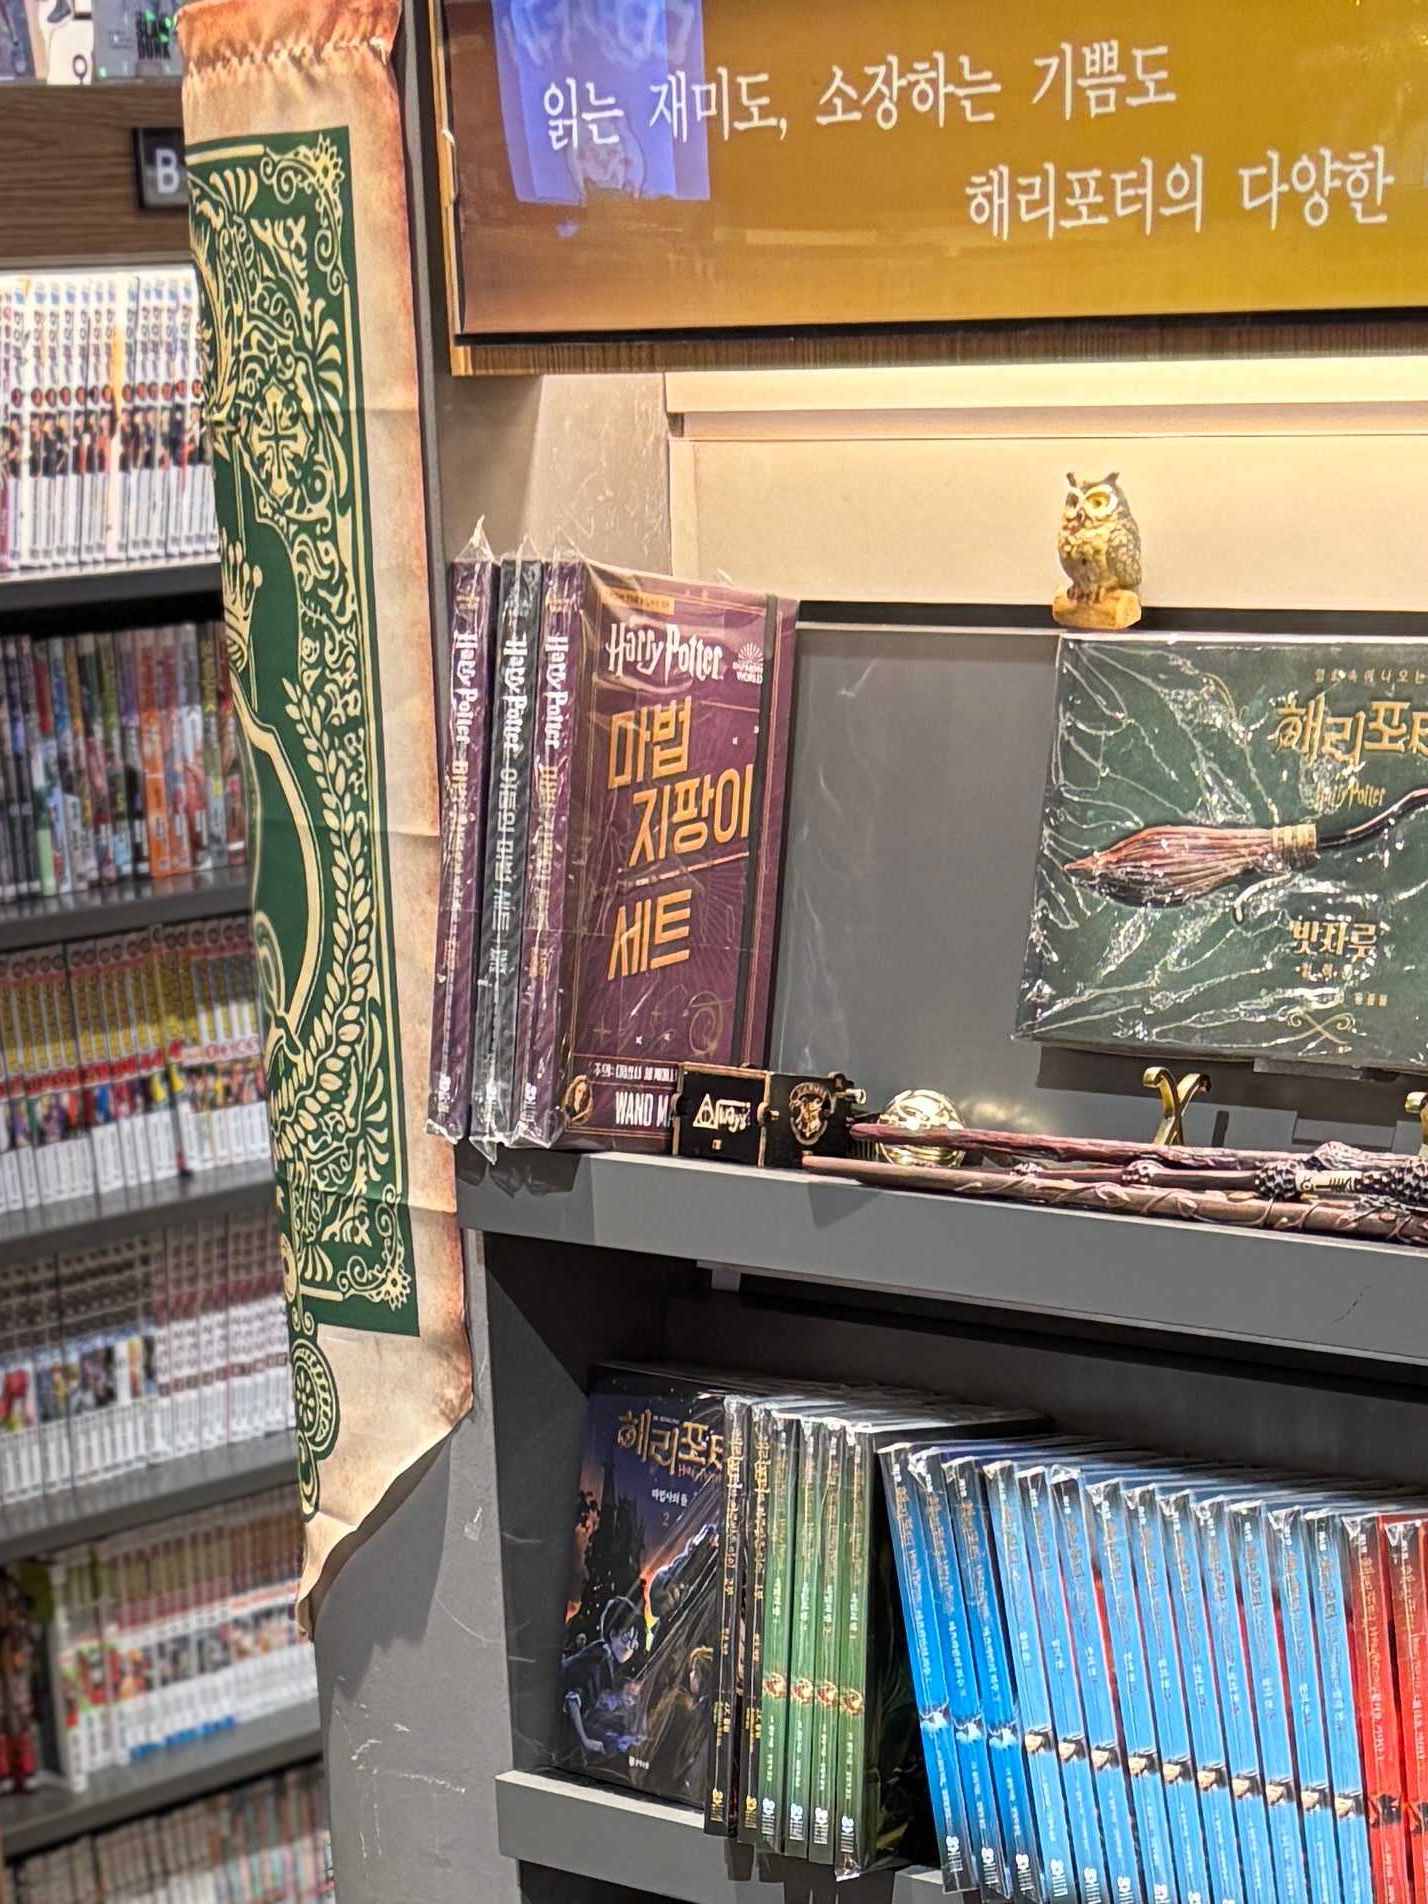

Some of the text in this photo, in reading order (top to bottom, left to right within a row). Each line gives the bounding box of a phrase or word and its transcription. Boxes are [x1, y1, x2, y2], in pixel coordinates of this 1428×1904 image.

[543, 38, 1177, 151] 읽는 재미도, 소장하는 기쁨도
[964, 153, 1206, 243] 해리포터의
[1238, 143, 1396, 231] 다양한
[543, 636, 569, 749] Harry Potter
[605, 622, 724, 686] Harry Potter
[455, 689, 478, 744] Potter
[502, 696, 528, 753] Potter
[607, 696, 692, 790] 마법
[628, 763, 754, 867] 지팡이
[1347, 778, 1386, 812] Potter
[607, 889, 692, 981] 세트
[615, 1091, 653, 1127] WAND
